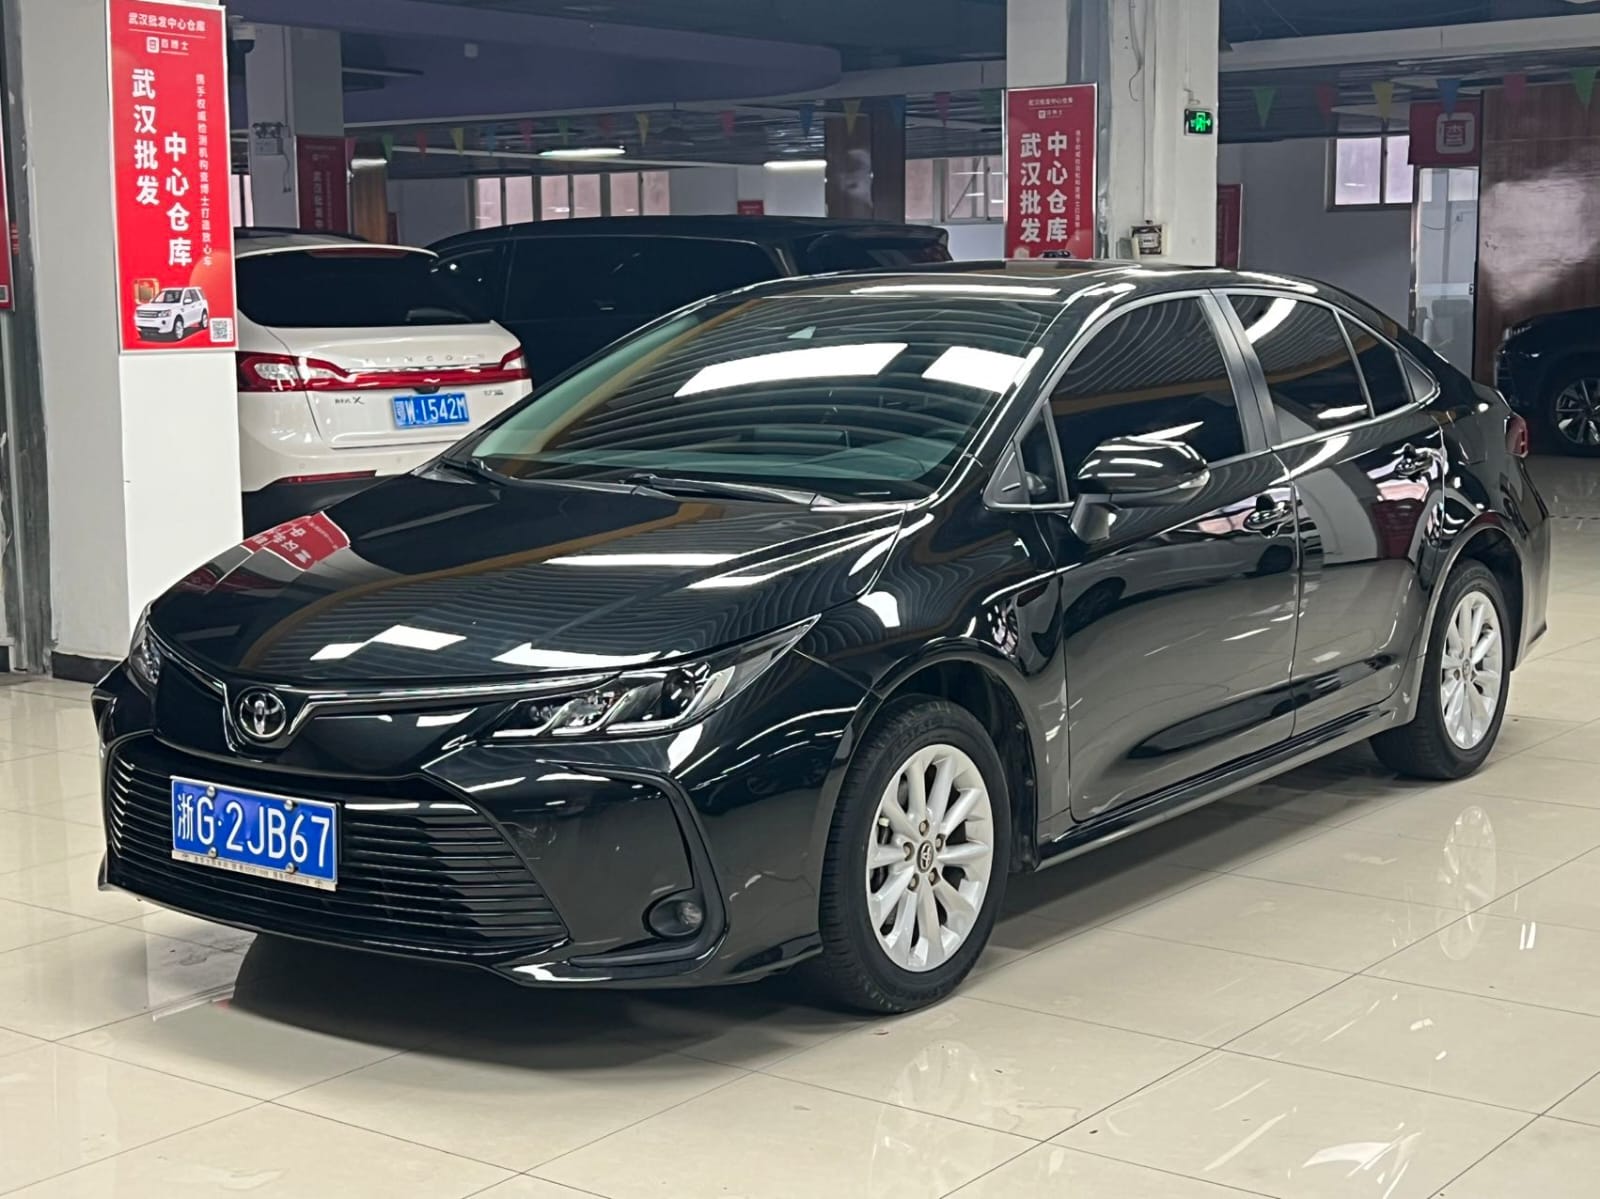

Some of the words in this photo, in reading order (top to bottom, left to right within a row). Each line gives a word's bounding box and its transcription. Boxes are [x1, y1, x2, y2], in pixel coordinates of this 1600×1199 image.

[128, 12, 207, 32] 武汉批发中心仓库
[131, 68, 160, 206] 武汉批发
[1020, 133, 1042, 243] 武汉批发
[1046, 131, 1069, 243] 中心仓库
[164, 131, 193, 267] 中心仓库
